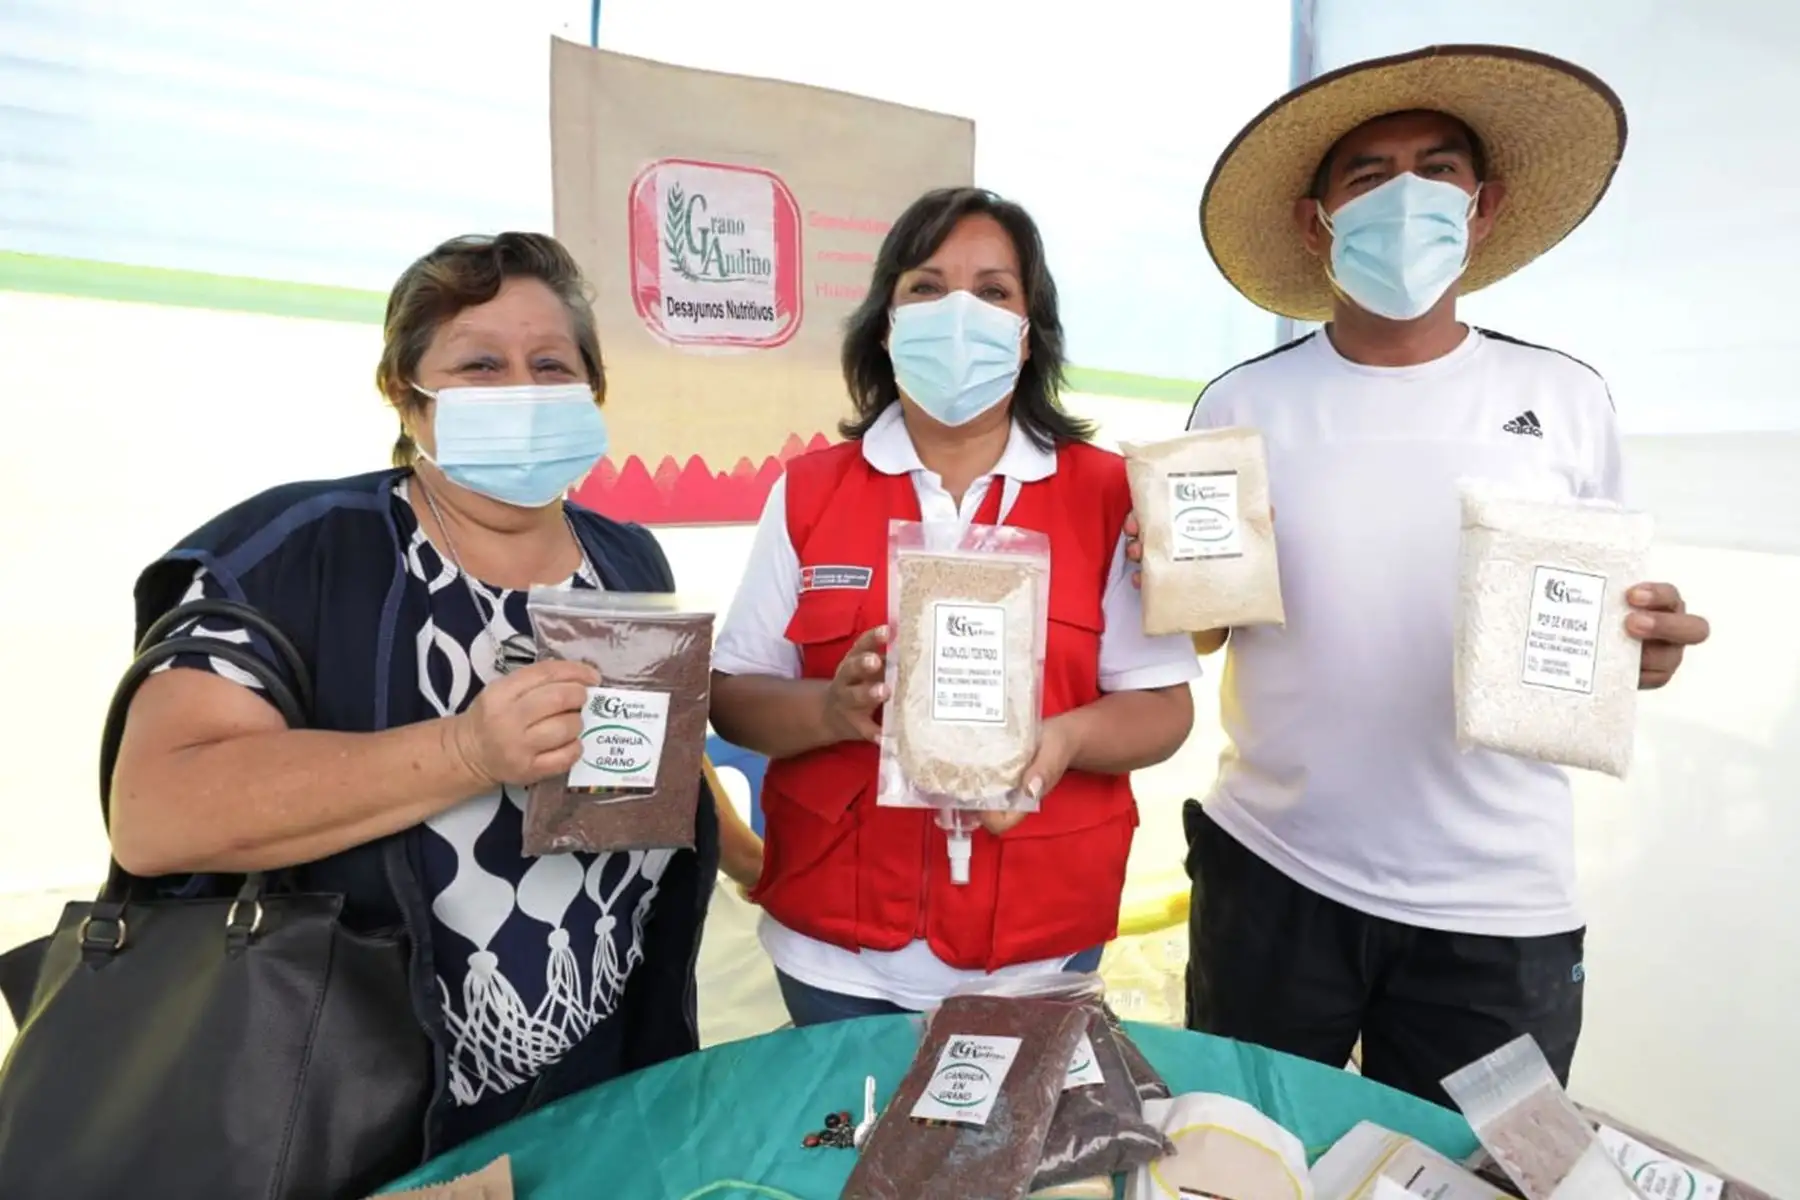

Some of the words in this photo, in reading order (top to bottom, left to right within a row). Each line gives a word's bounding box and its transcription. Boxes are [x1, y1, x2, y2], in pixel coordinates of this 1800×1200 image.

[685, 194, 745, 263] Grano
[700, 237, 771, 277] Andino
[666, 297, 724, 323] Desayunos
[726, 300, 774, 322] Nutritivos
[595, 756, 635, 767] GRANO
[609, 747, 625, 755] EN
